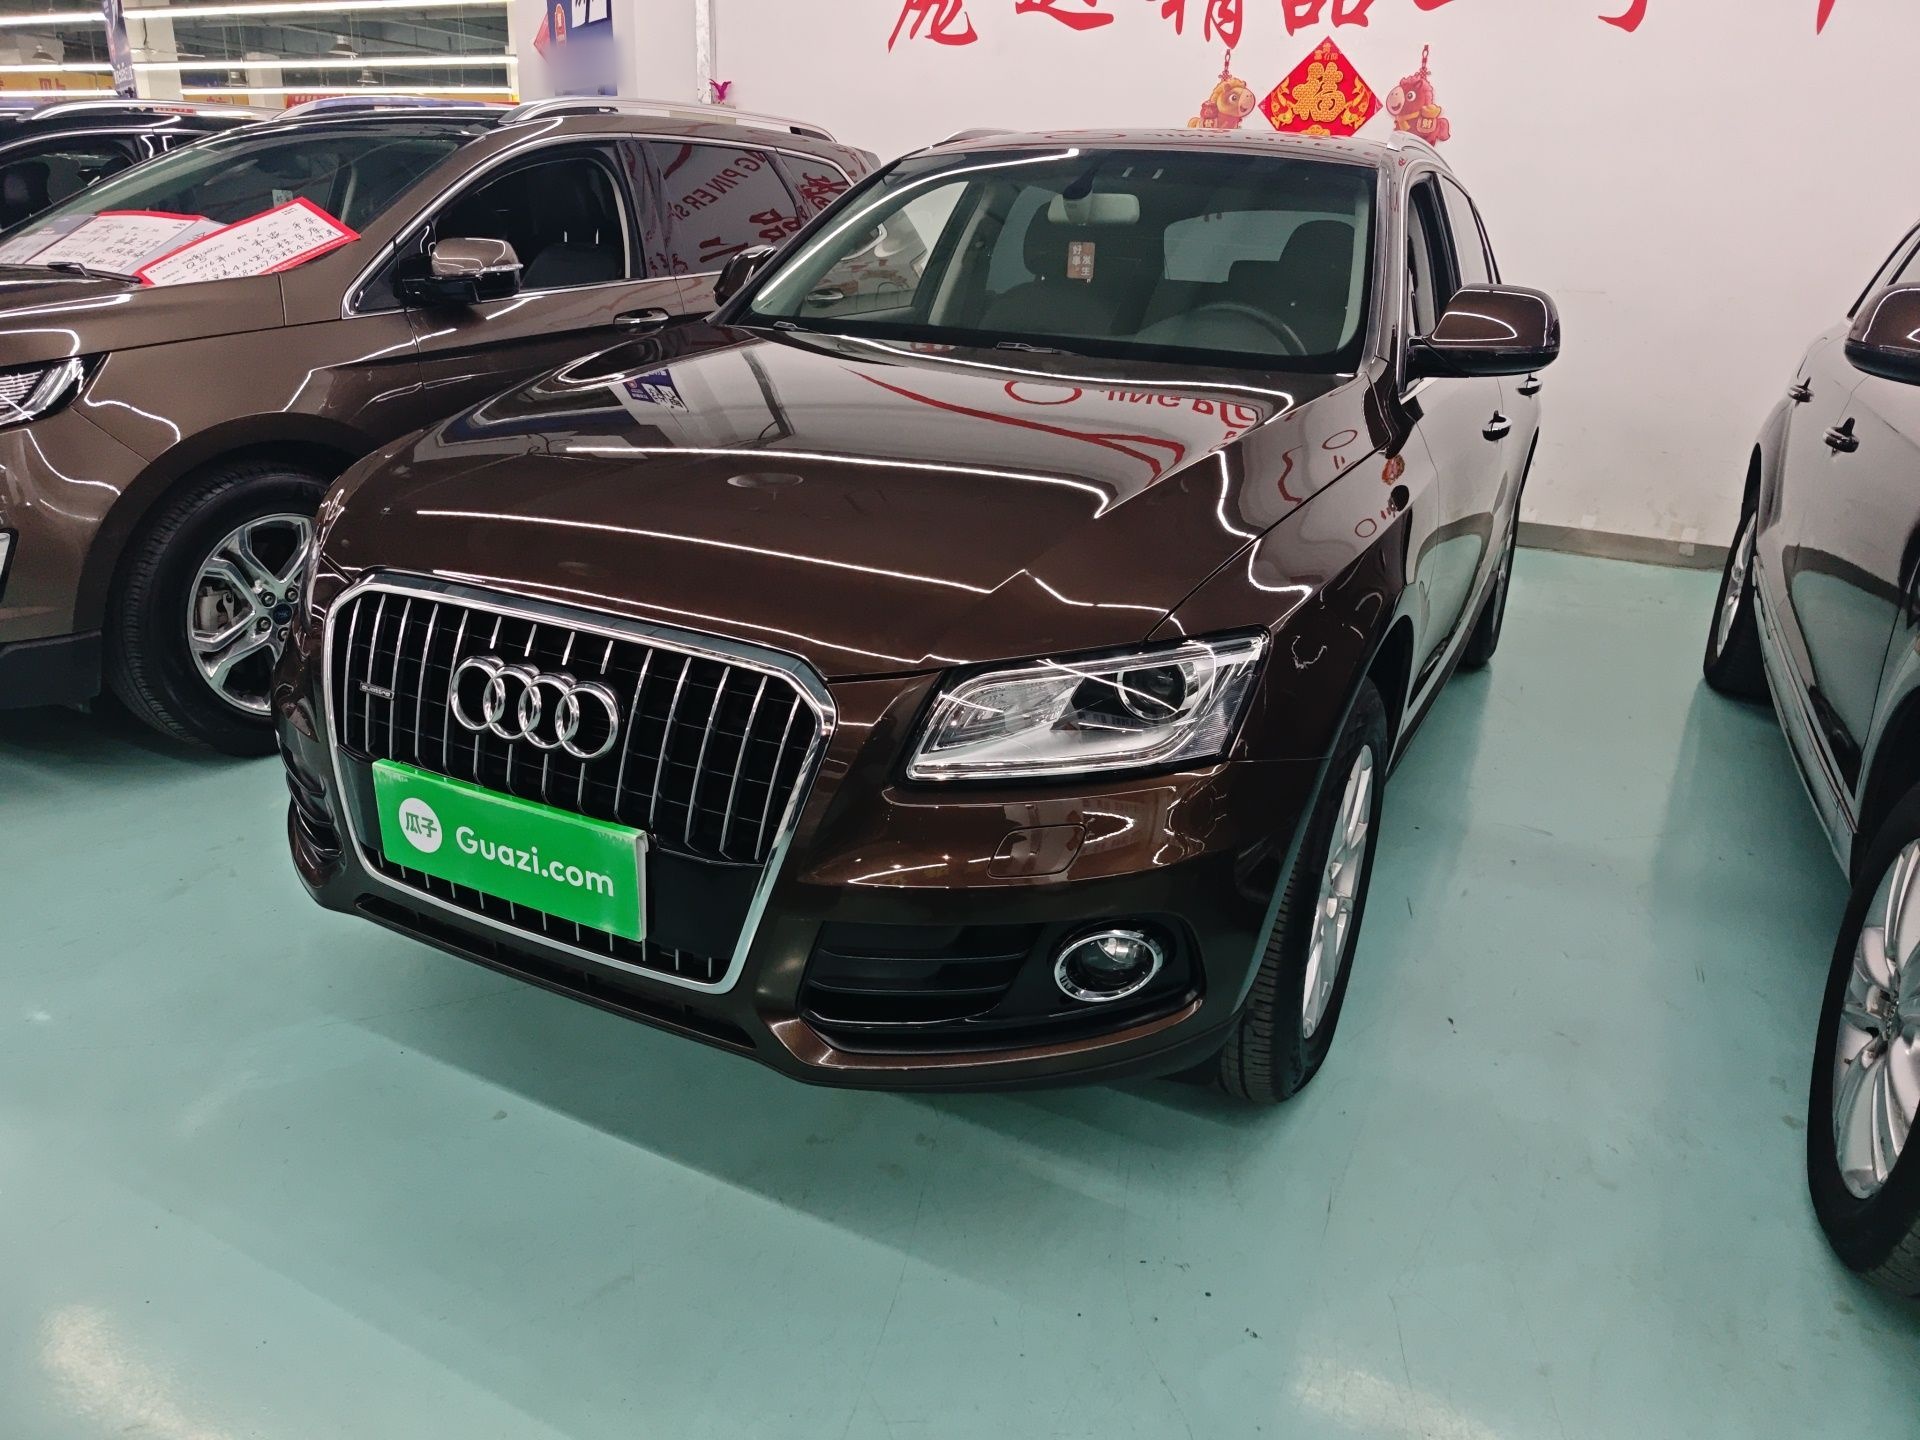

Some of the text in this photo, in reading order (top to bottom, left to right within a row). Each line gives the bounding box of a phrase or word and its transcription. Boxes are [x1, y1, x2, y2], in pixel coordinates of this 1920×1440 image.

[1291, 61, 1345, 123] 福
[361, 684, 392, 698] quattro
[405, 811, 437, 838] 瓜子
[456, 826, 614, 897] Guazi.com
